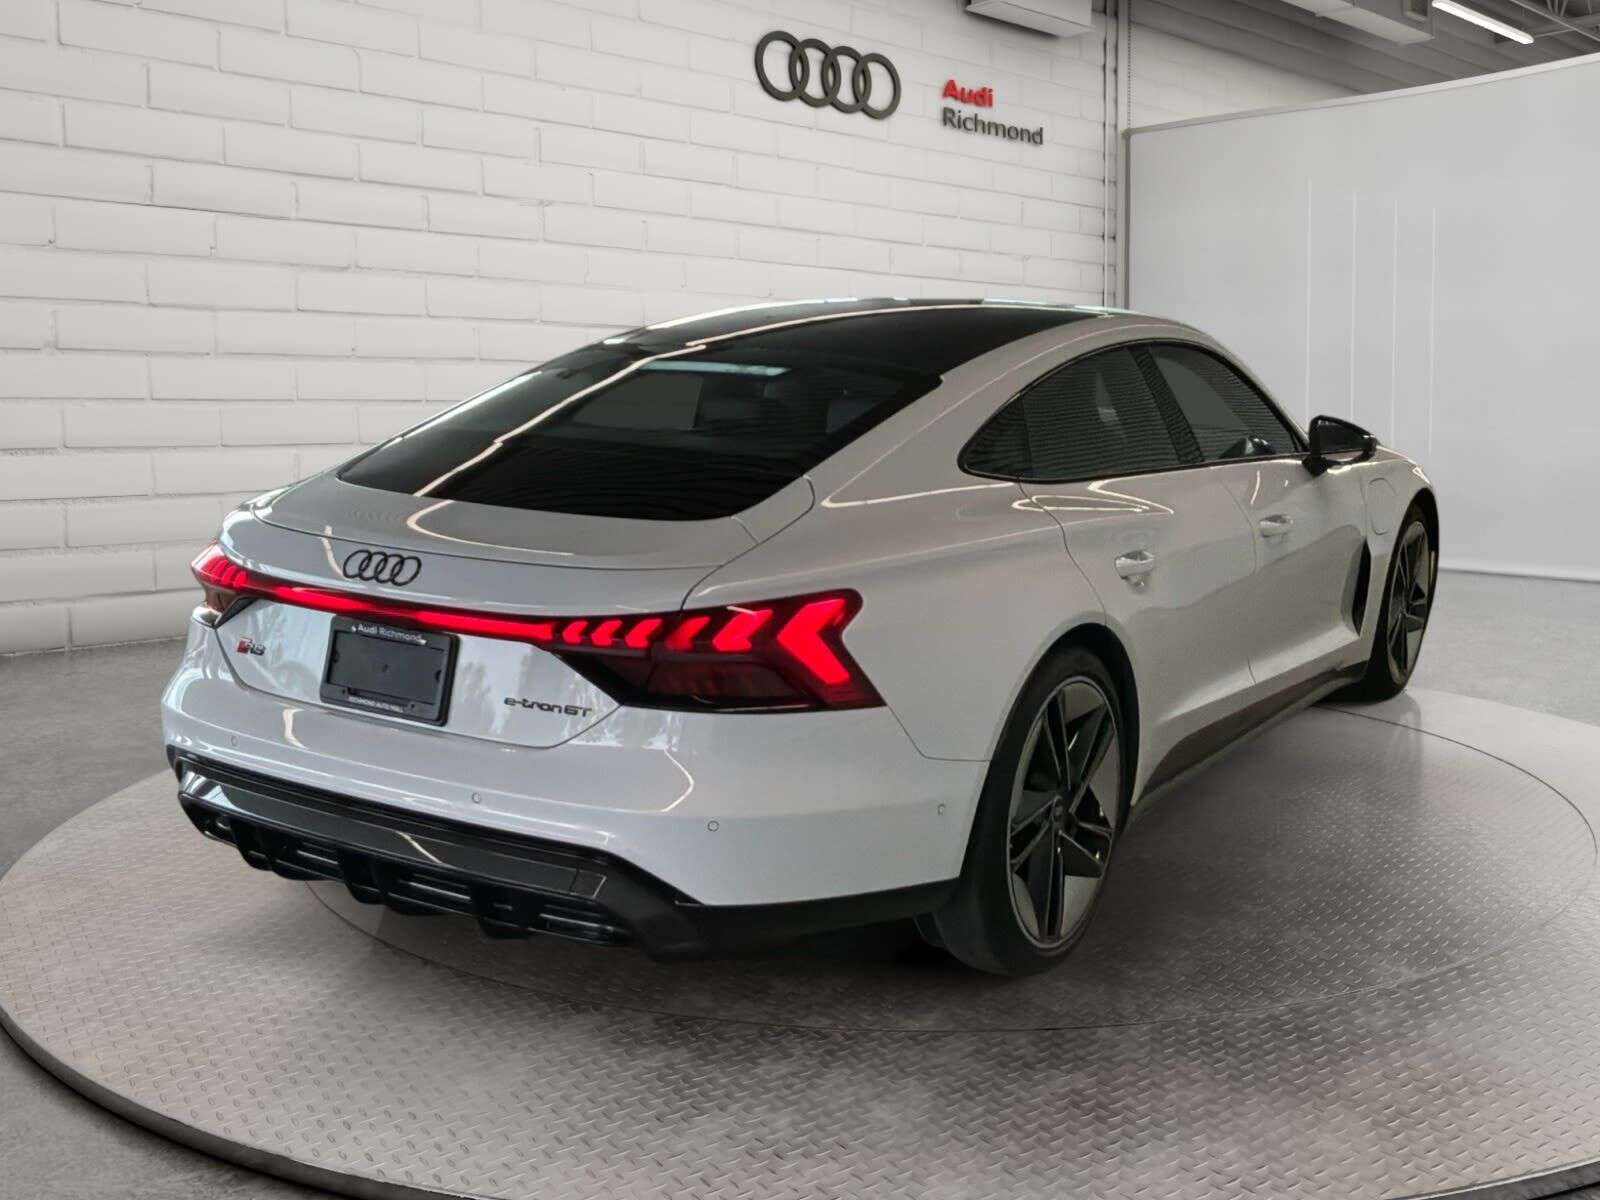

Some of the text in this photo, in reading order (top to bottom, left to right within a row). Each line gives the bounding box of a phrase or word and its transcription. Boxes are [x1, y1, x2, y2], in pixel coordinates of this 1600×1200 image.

[943, 79, 993, 108] Audi
[942, 106, 1044, 145] Richmond
[358, 623, 422, 641] Audi Richmond
[503, 697, 593, 718] e-tron GT
